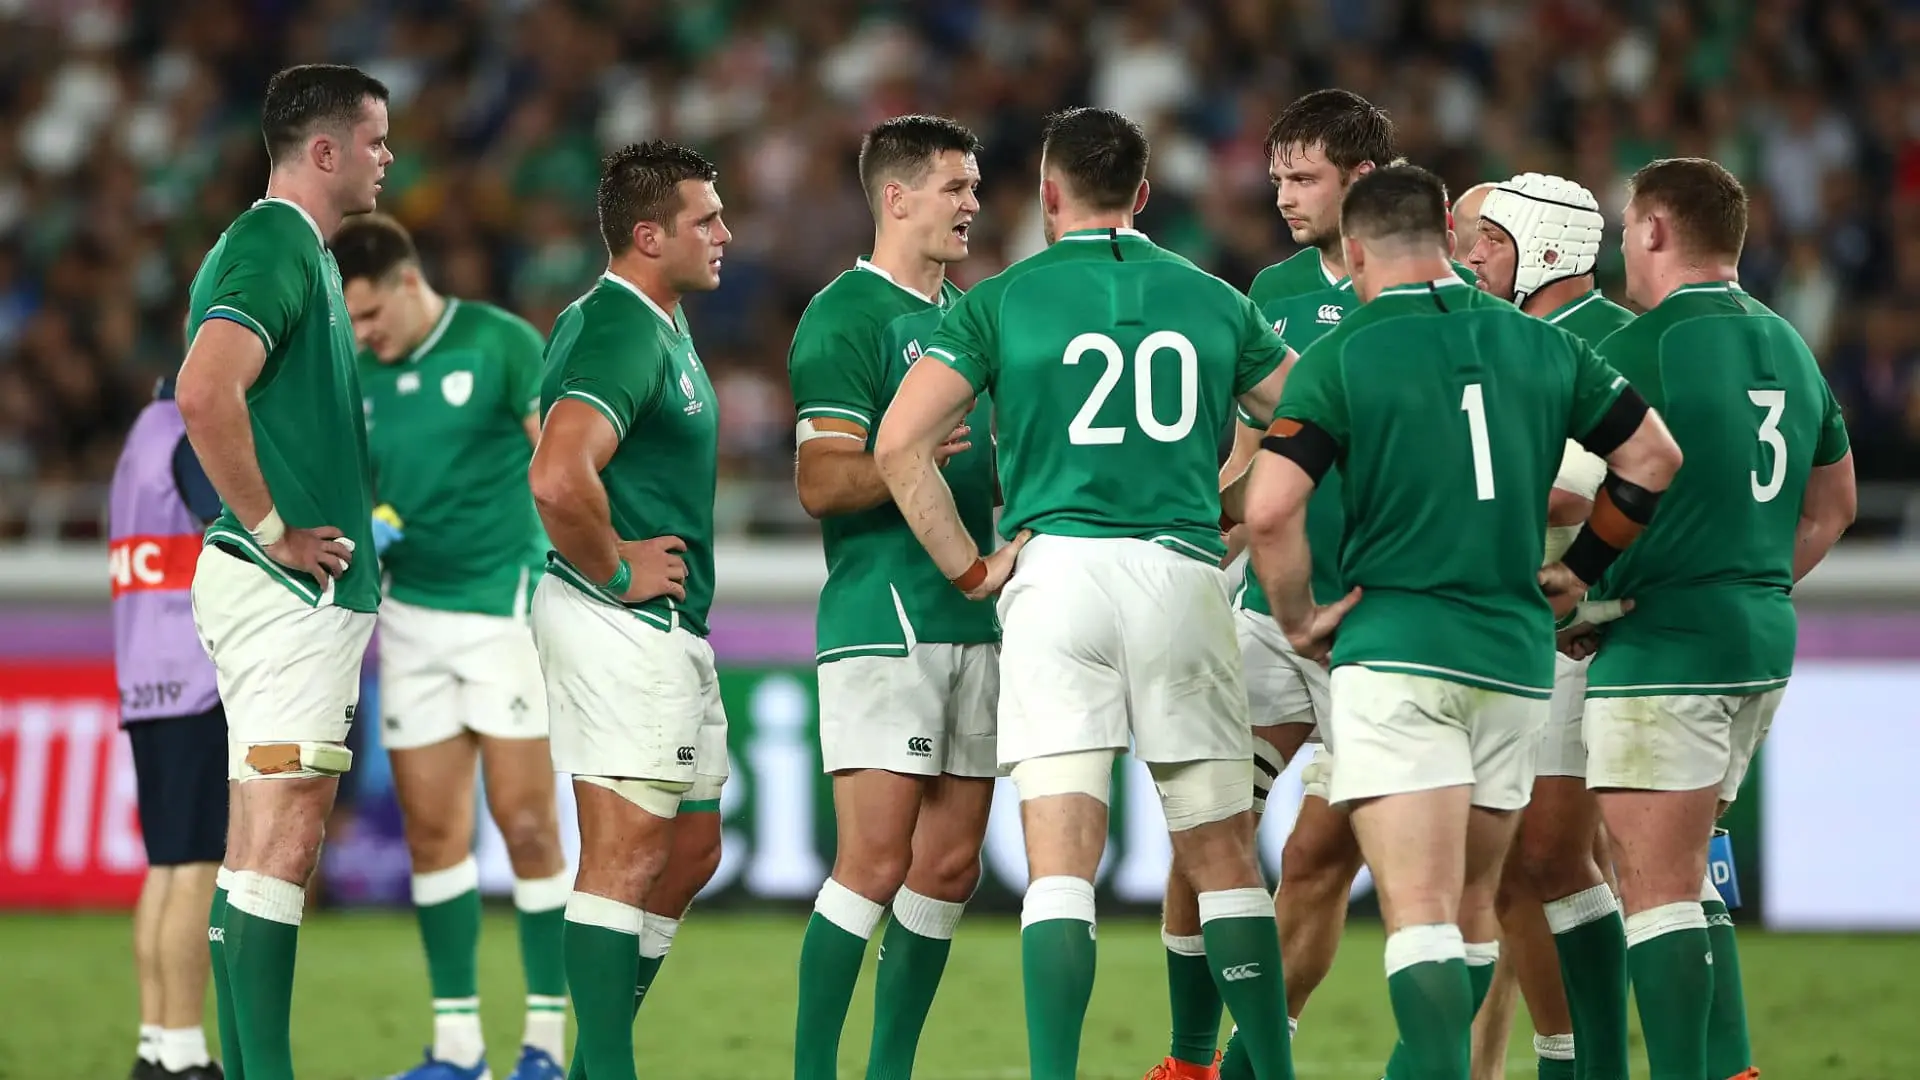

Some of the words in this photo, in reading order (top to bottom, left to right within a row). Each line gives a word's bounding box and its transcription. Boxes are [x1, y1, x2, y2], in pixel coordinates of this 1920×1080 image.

[1062, 330, 1198, 445] 20
[1460, 383, 1496, 501] 1
[1747, 390, 1788, 503] 3
